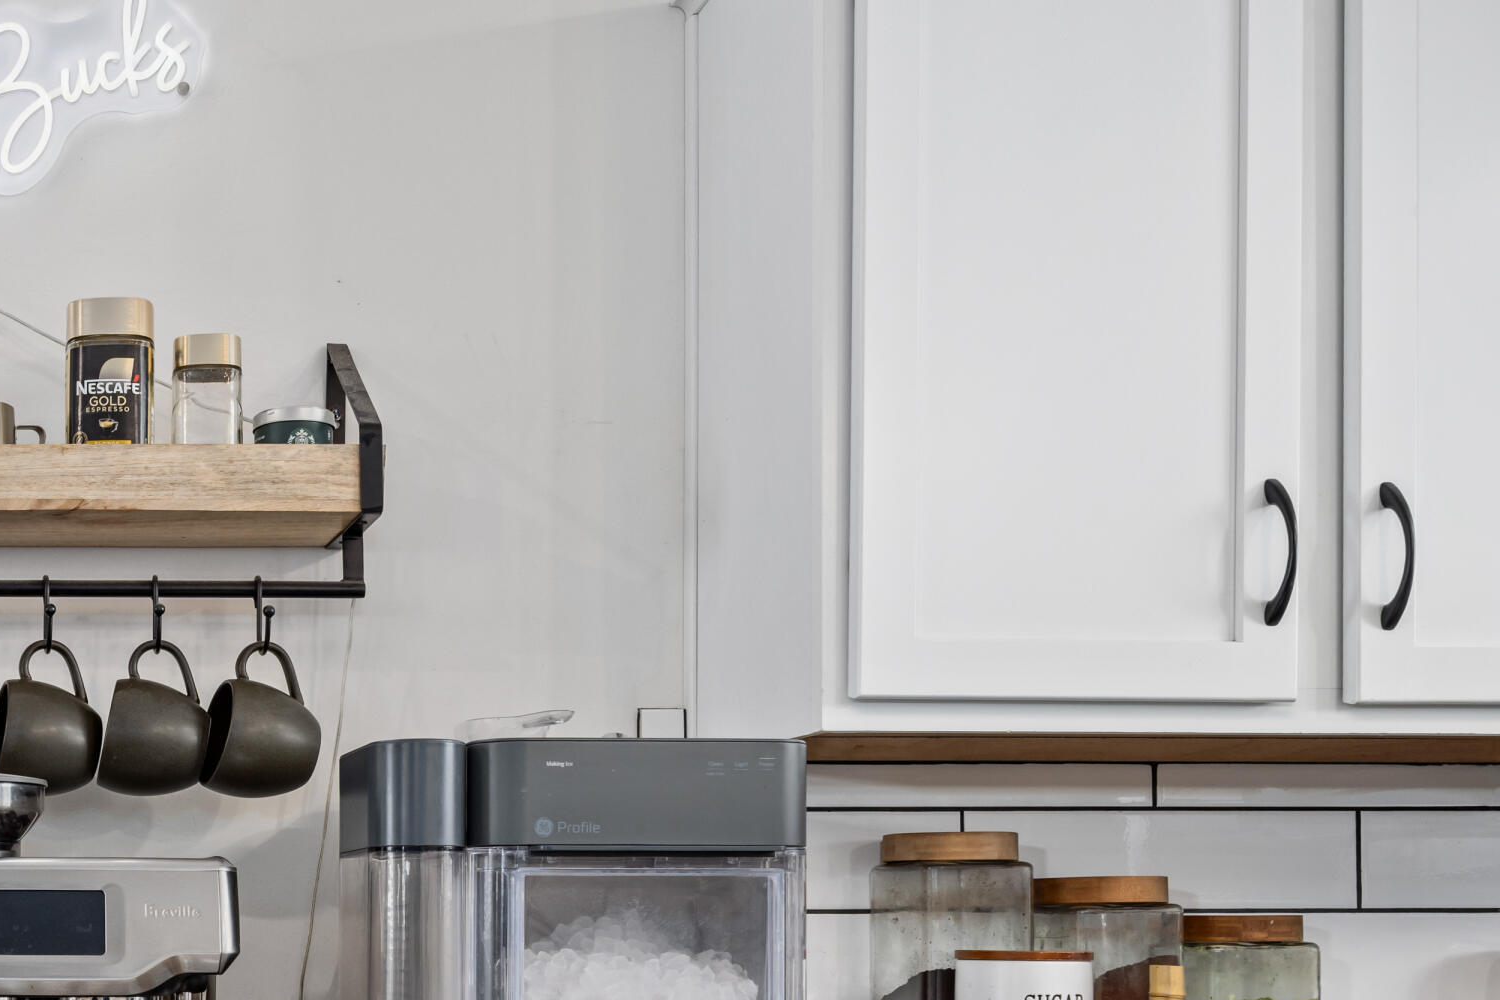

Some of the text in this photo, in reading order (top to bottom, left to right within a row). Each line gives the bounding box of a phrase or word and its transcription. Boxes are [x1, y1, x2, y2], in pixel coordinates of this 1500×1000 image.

[76, 374, 141, 396] NESCAFÉ
[89, 395, 127, 407] GOLD
[557, 821, 601, 833] Profile
[144, 903, 201, 918] Breville
